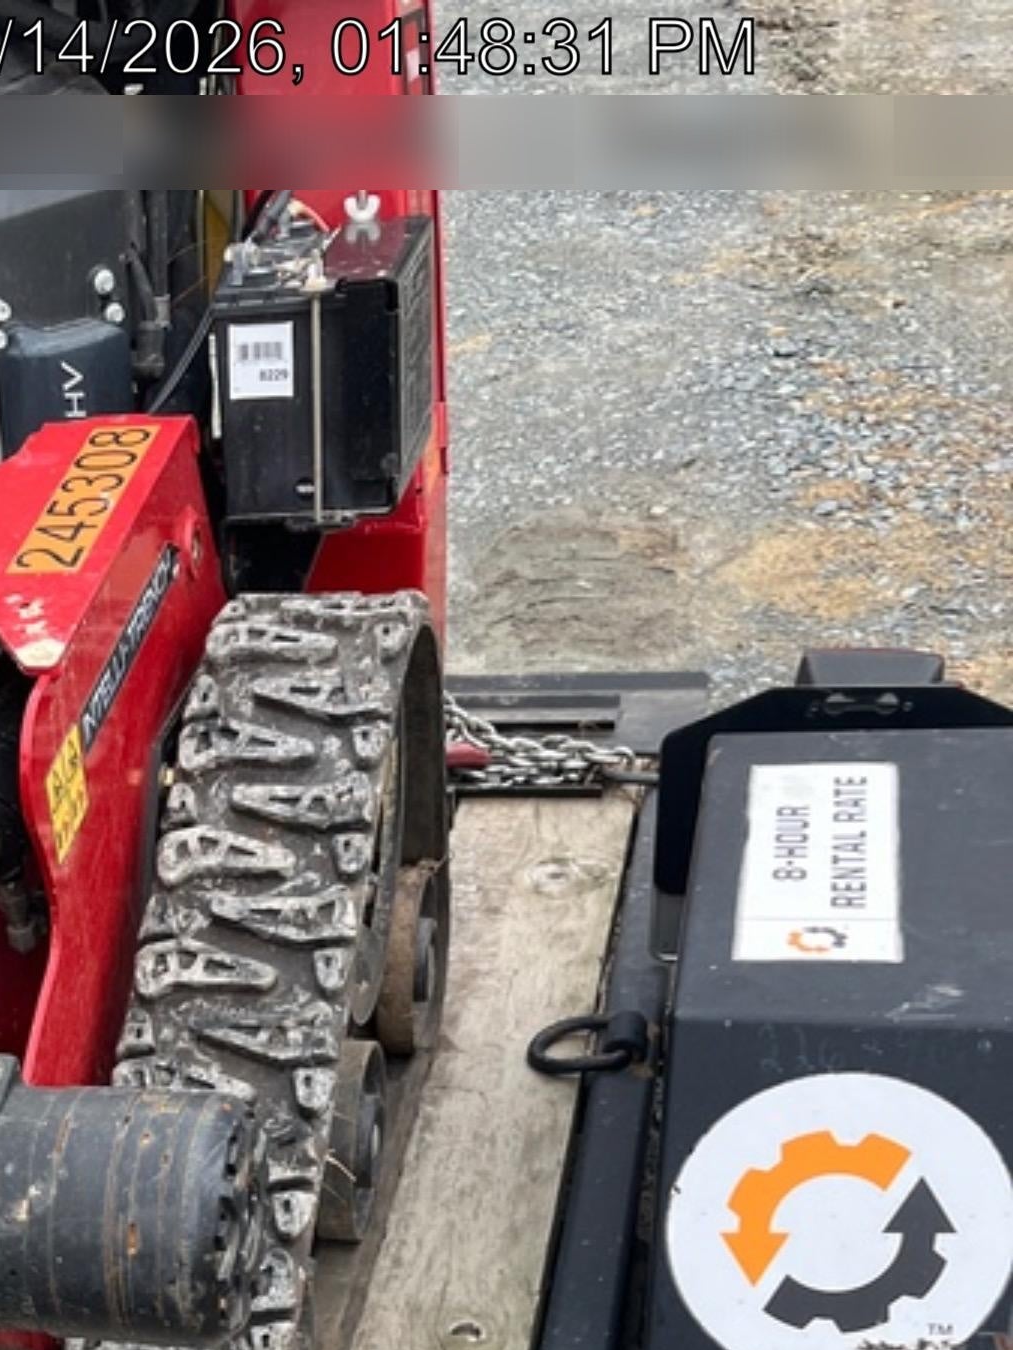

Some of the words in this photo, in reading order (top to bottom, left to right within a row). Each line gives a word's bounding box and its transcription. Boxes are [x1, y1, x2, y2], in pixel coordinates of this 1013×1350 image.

[15, 428, 151, 568] 245308
[832, 776, 868, 822] RATE
[772, 806, 811, 881] 8-HOUR
[830, 830, 868, 908] RENTAL
